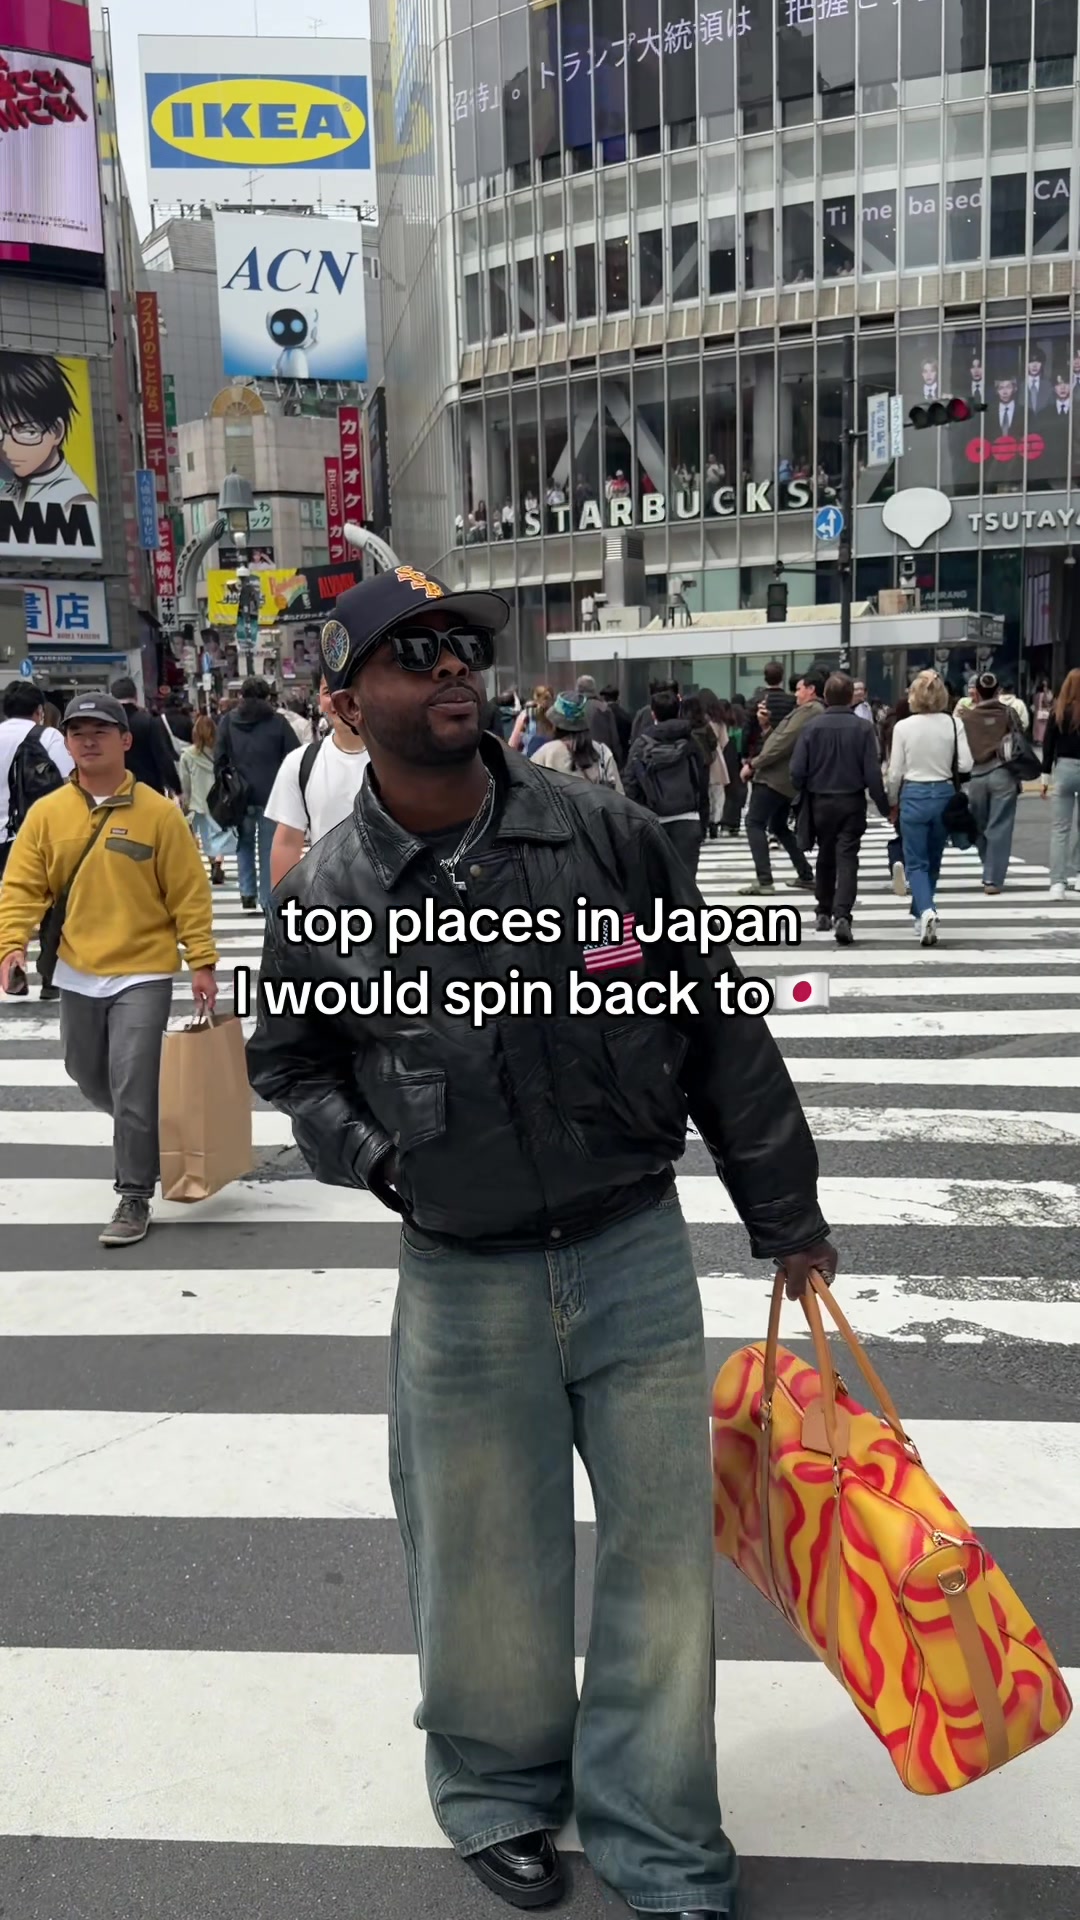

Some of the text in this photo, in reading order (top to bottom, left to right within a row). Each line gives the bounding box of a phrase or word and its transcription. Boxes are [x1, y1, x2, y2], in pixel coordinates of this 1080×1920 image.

[171, 102, 351, 139] IKEA
[826, 203, 892, 227] Time
[908, 186, 984, 216] based
[221, 245, 359, 295] ACN
[341, 418, 362, 529] カラオケ
[524, 479, 810, 537] STARBUCKS
